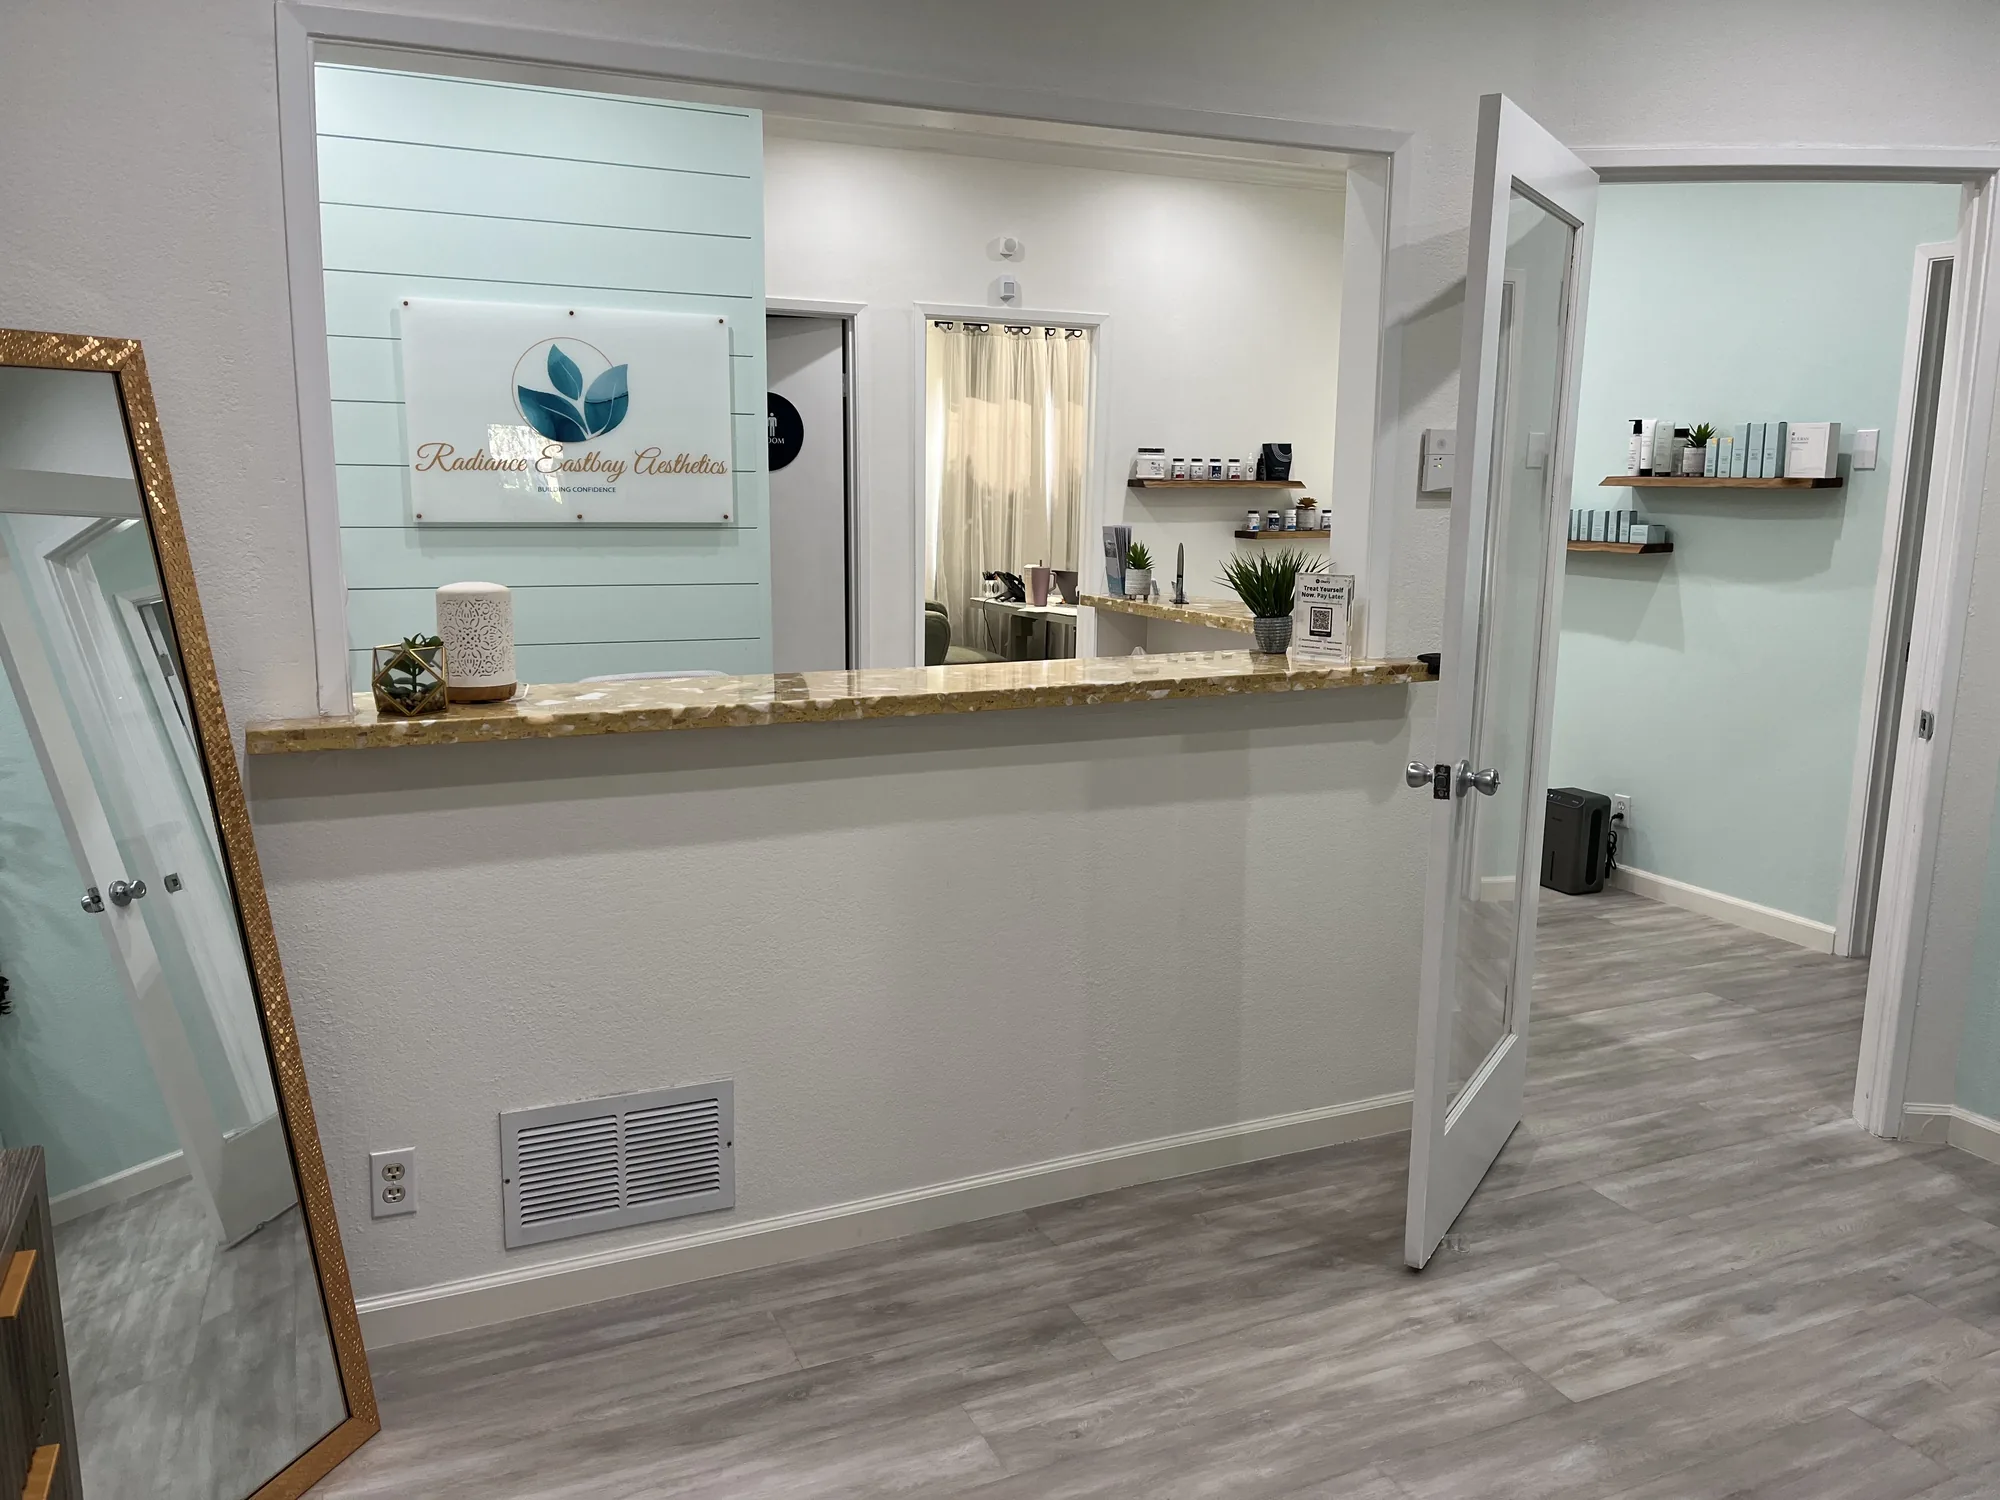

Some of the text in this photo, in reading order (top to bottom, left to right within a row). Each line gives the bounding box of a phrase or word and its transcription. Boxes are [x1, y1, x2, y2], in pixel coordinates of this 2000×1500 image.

[415, 442, 728, 483] Radiance Eastbay Aesthetics
[1317, 592, 1328, 600] Pay
